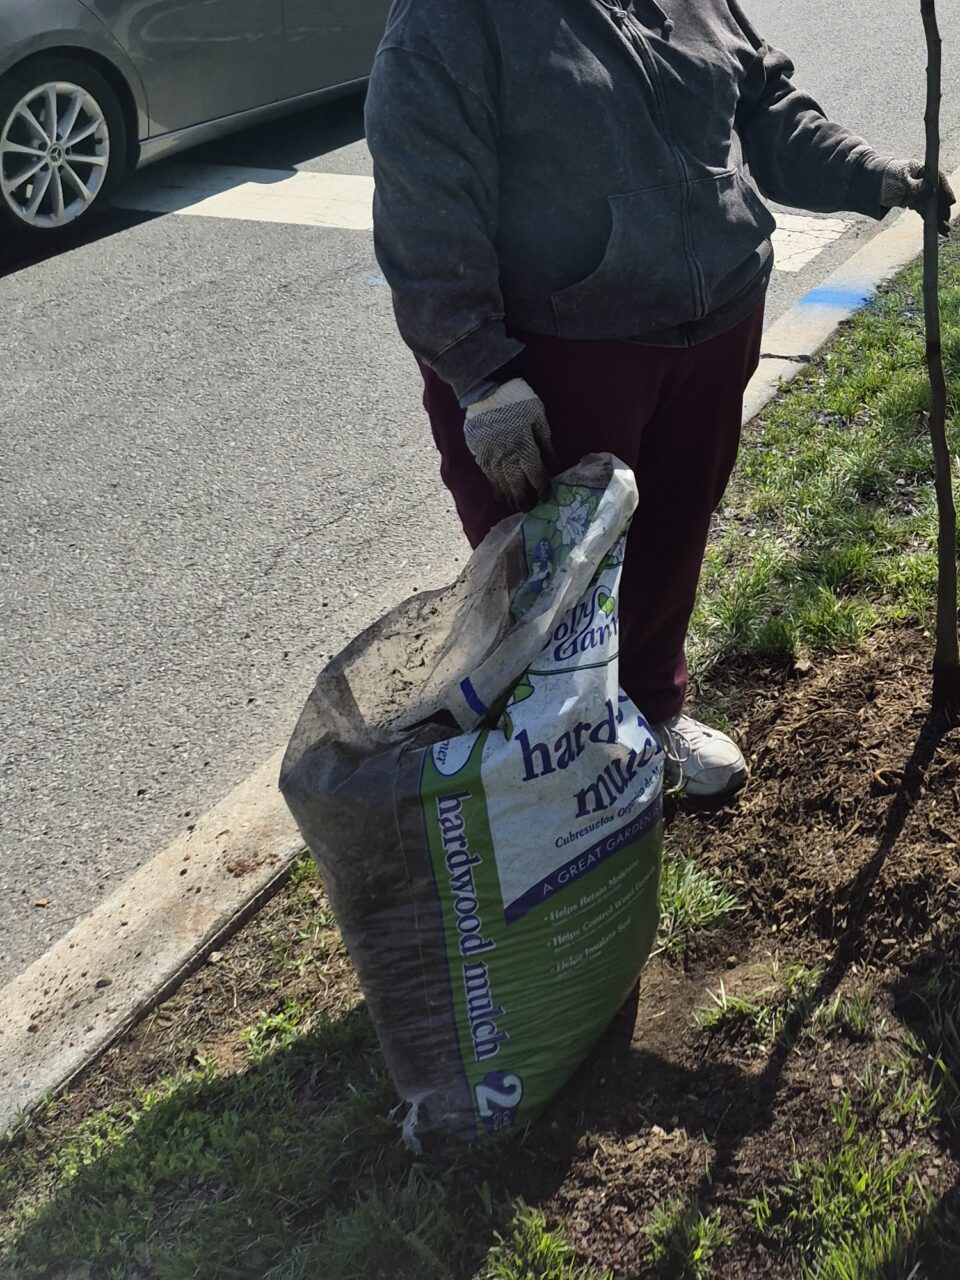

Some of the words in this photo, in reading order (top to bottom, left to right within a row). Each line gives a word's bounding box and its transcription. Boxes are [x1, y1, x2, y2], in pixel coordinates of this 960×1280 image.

[436, 790, 497, 956] hardwood
[542, 882, 555, 897] A
[557, 846, 603, 886] GREAT
[549, 902, 578, 922] Helps
[552, 928, 580, 948] Helps
[462, 961, 510, 1061] mulch
[475, 1074, 523, 1118] 2
